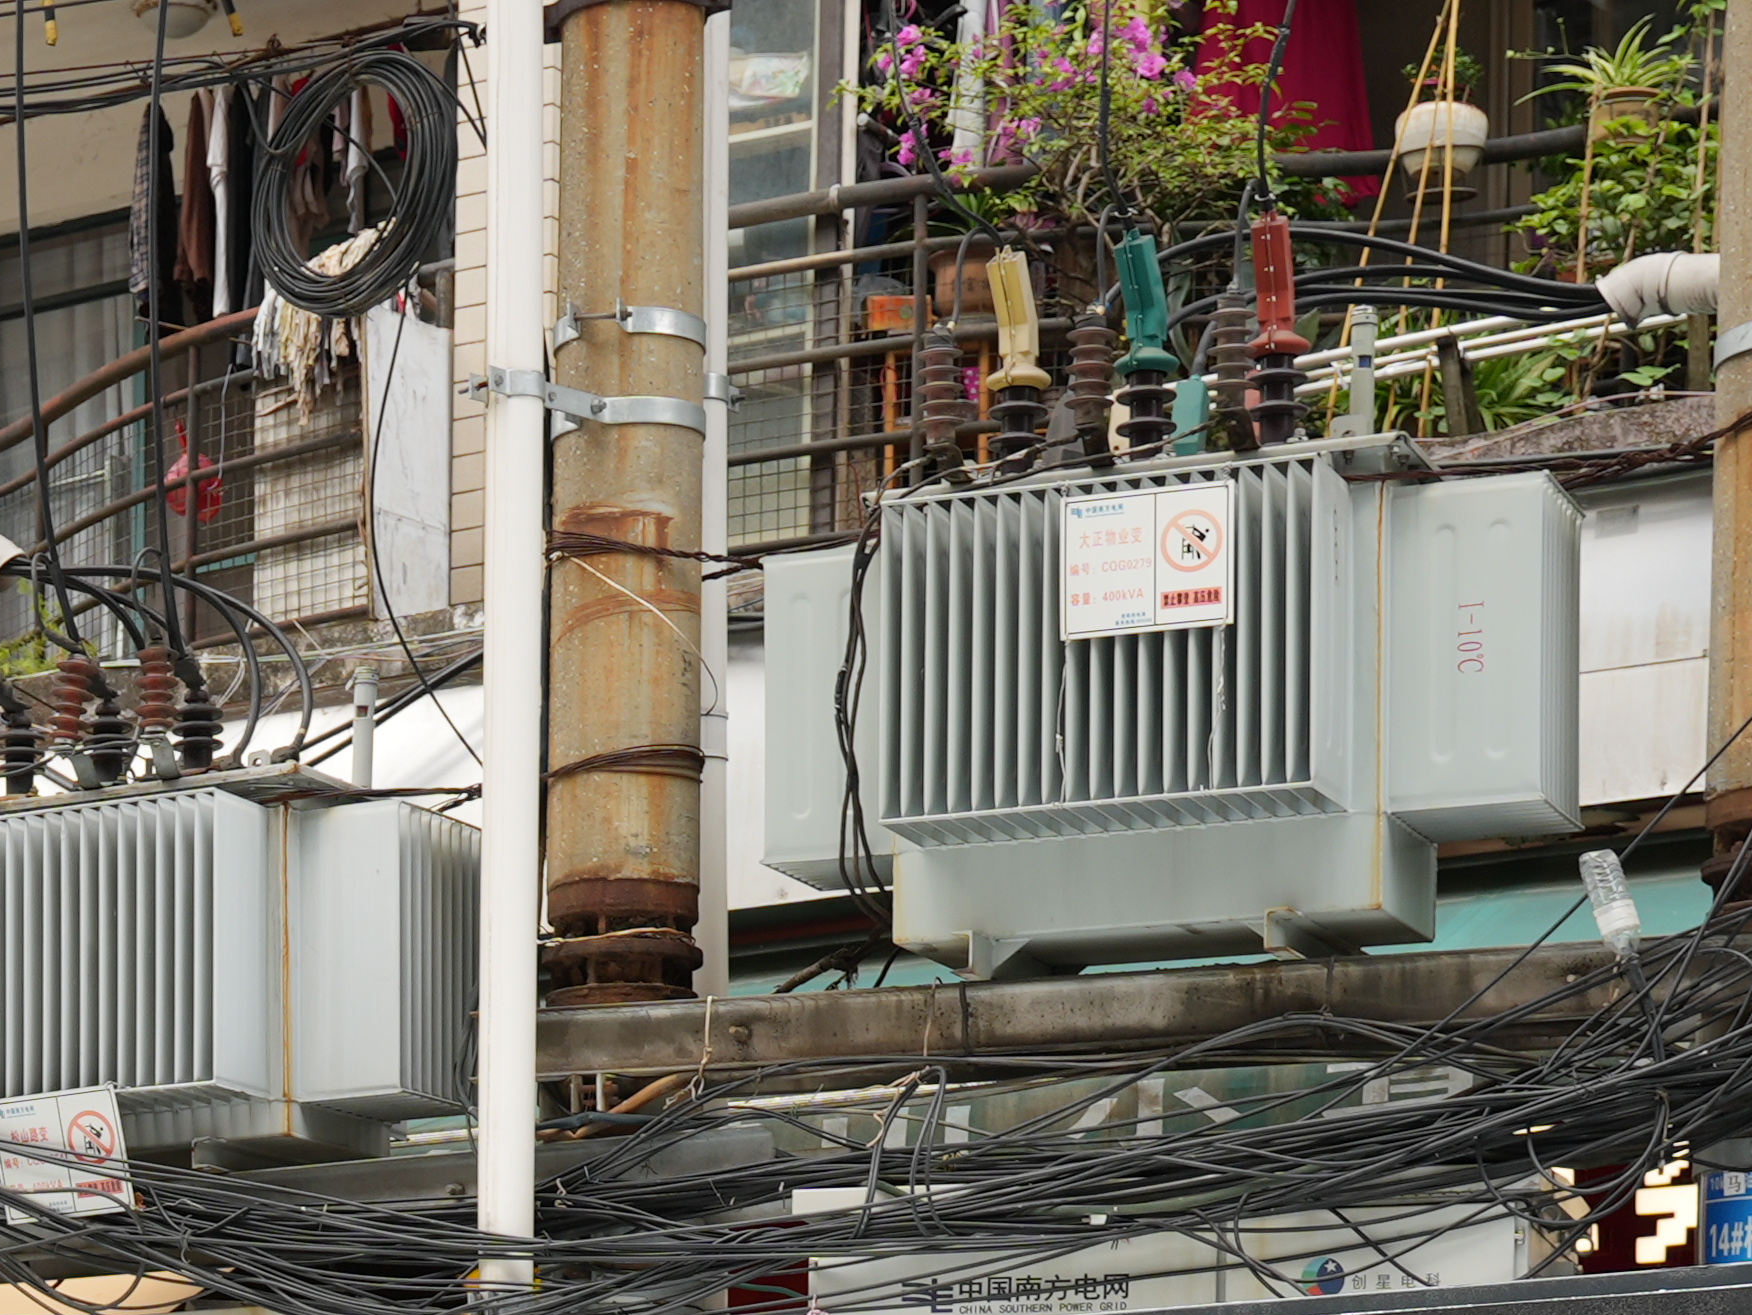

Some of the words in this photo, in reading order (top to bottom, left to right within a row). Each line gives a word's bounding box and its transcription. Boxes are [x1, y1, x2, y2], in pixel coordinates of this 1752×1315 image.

[1102, 587, 1144, 602] 400kVA
[957, 1273, 1130, 1302] 中国南方电网
[958, 1305, 994, 1315] CHINA
[998, 1303, 1052, 1315] SOUTHERN
[1055, 1302, 1095, 1313] POWER
[1099, 1300, 1129, 1312] GRID
